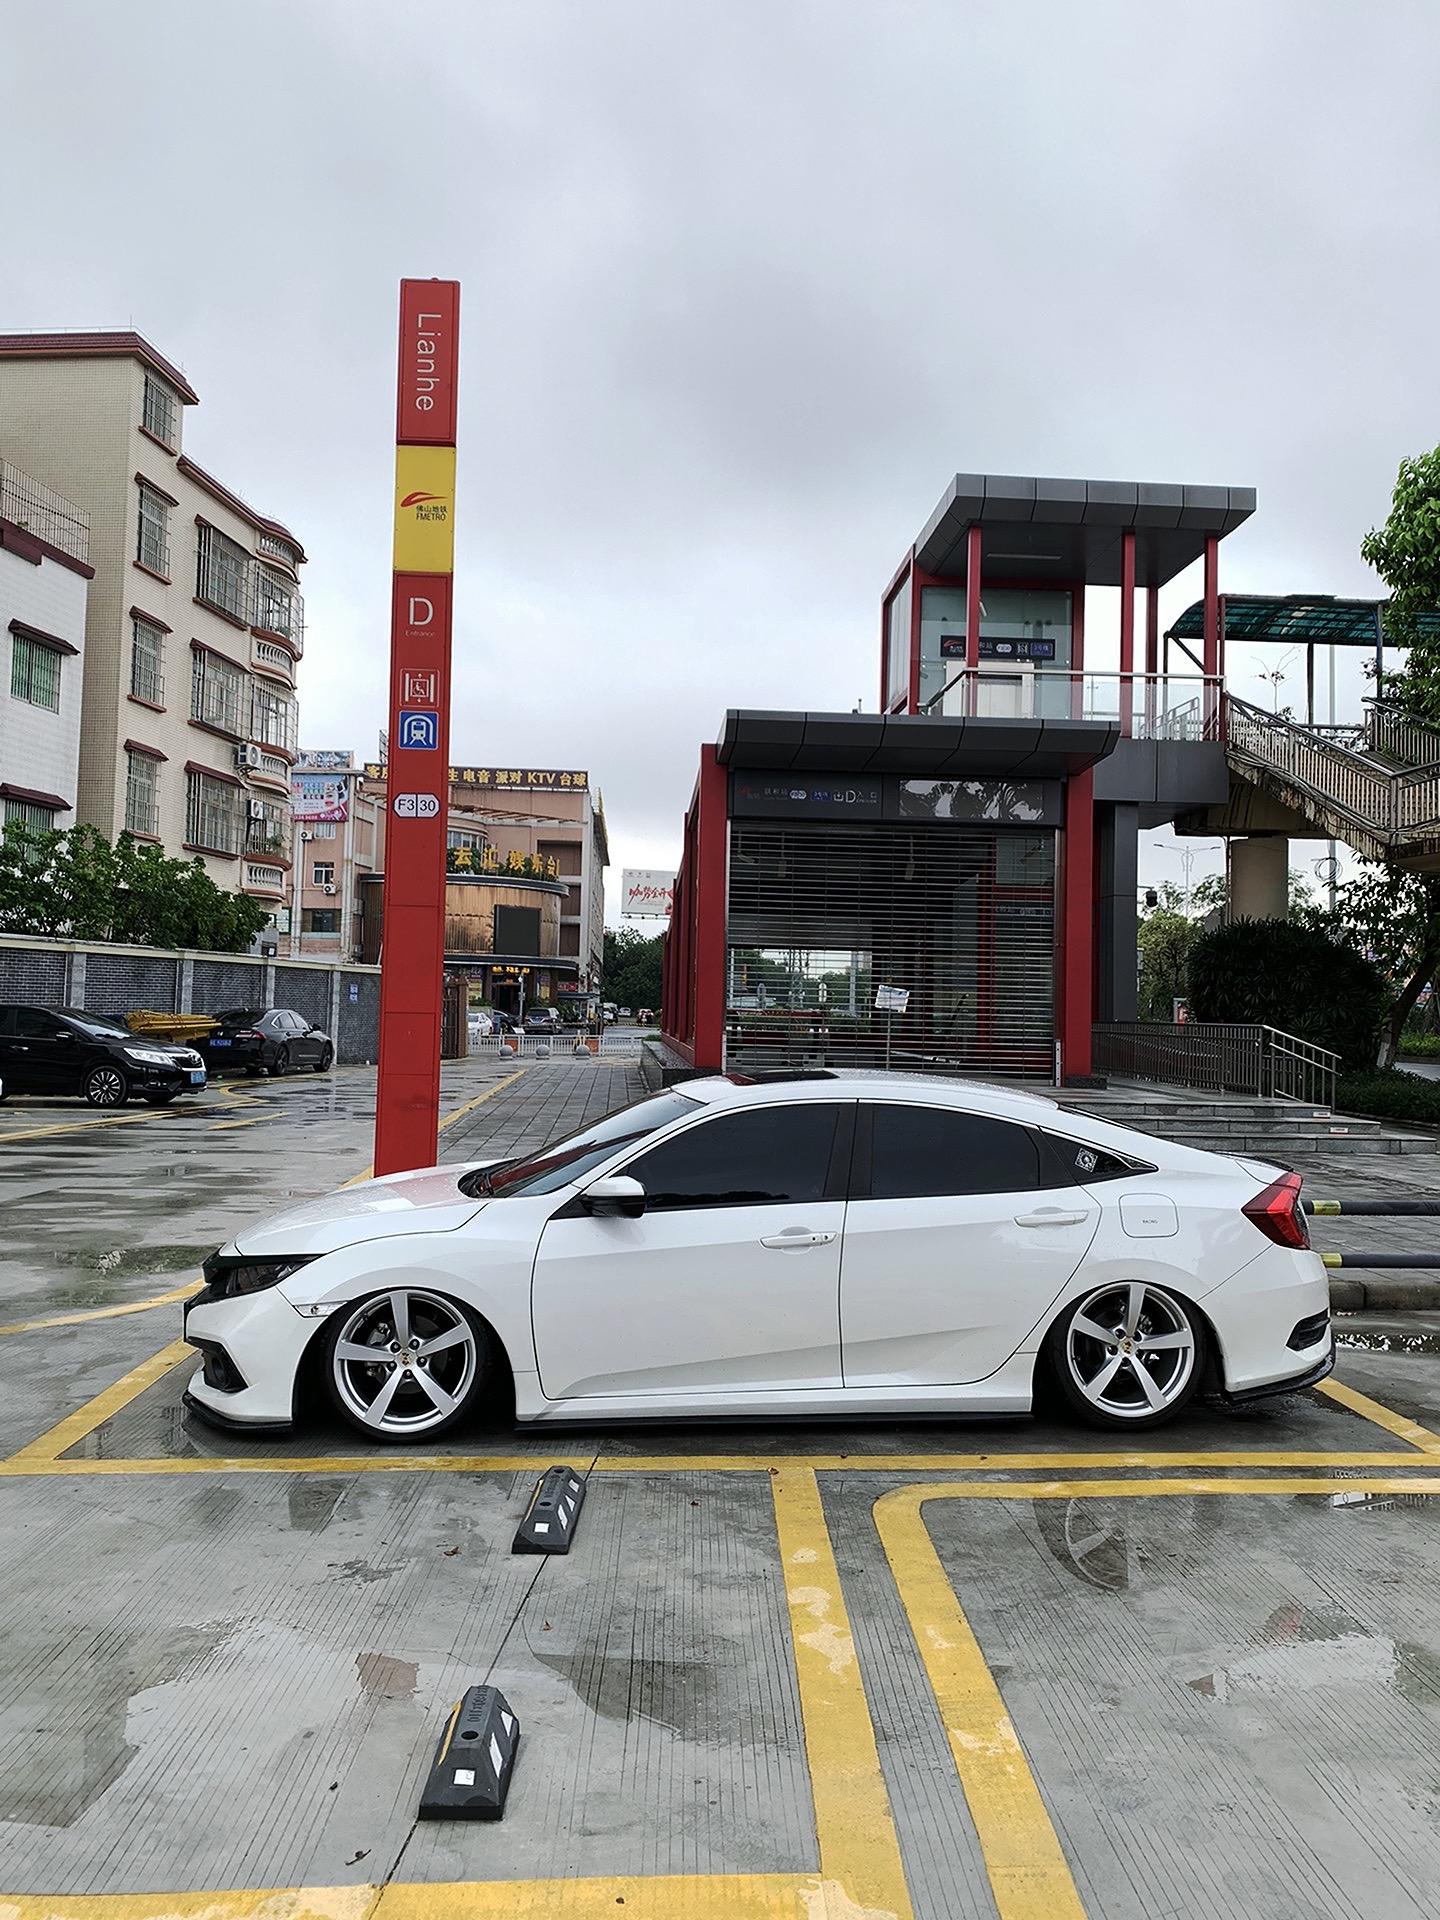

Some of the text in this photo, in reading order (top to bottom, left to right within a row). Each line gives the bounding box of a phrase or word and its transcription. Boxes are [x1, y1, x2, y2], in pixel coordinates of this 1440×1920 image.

[415, 313, 442, 411] Lianhe
[416, 513, 446, 521] FMETRO
[409, 597, 434, 626] D
[463, 769, 490, 784] 电音
[527, 772, 556, 783] KTV
[559, 773, 587, 786] 台球
[845, 790, 857, 803] D
[398, 799, 436, 812] F3 30
